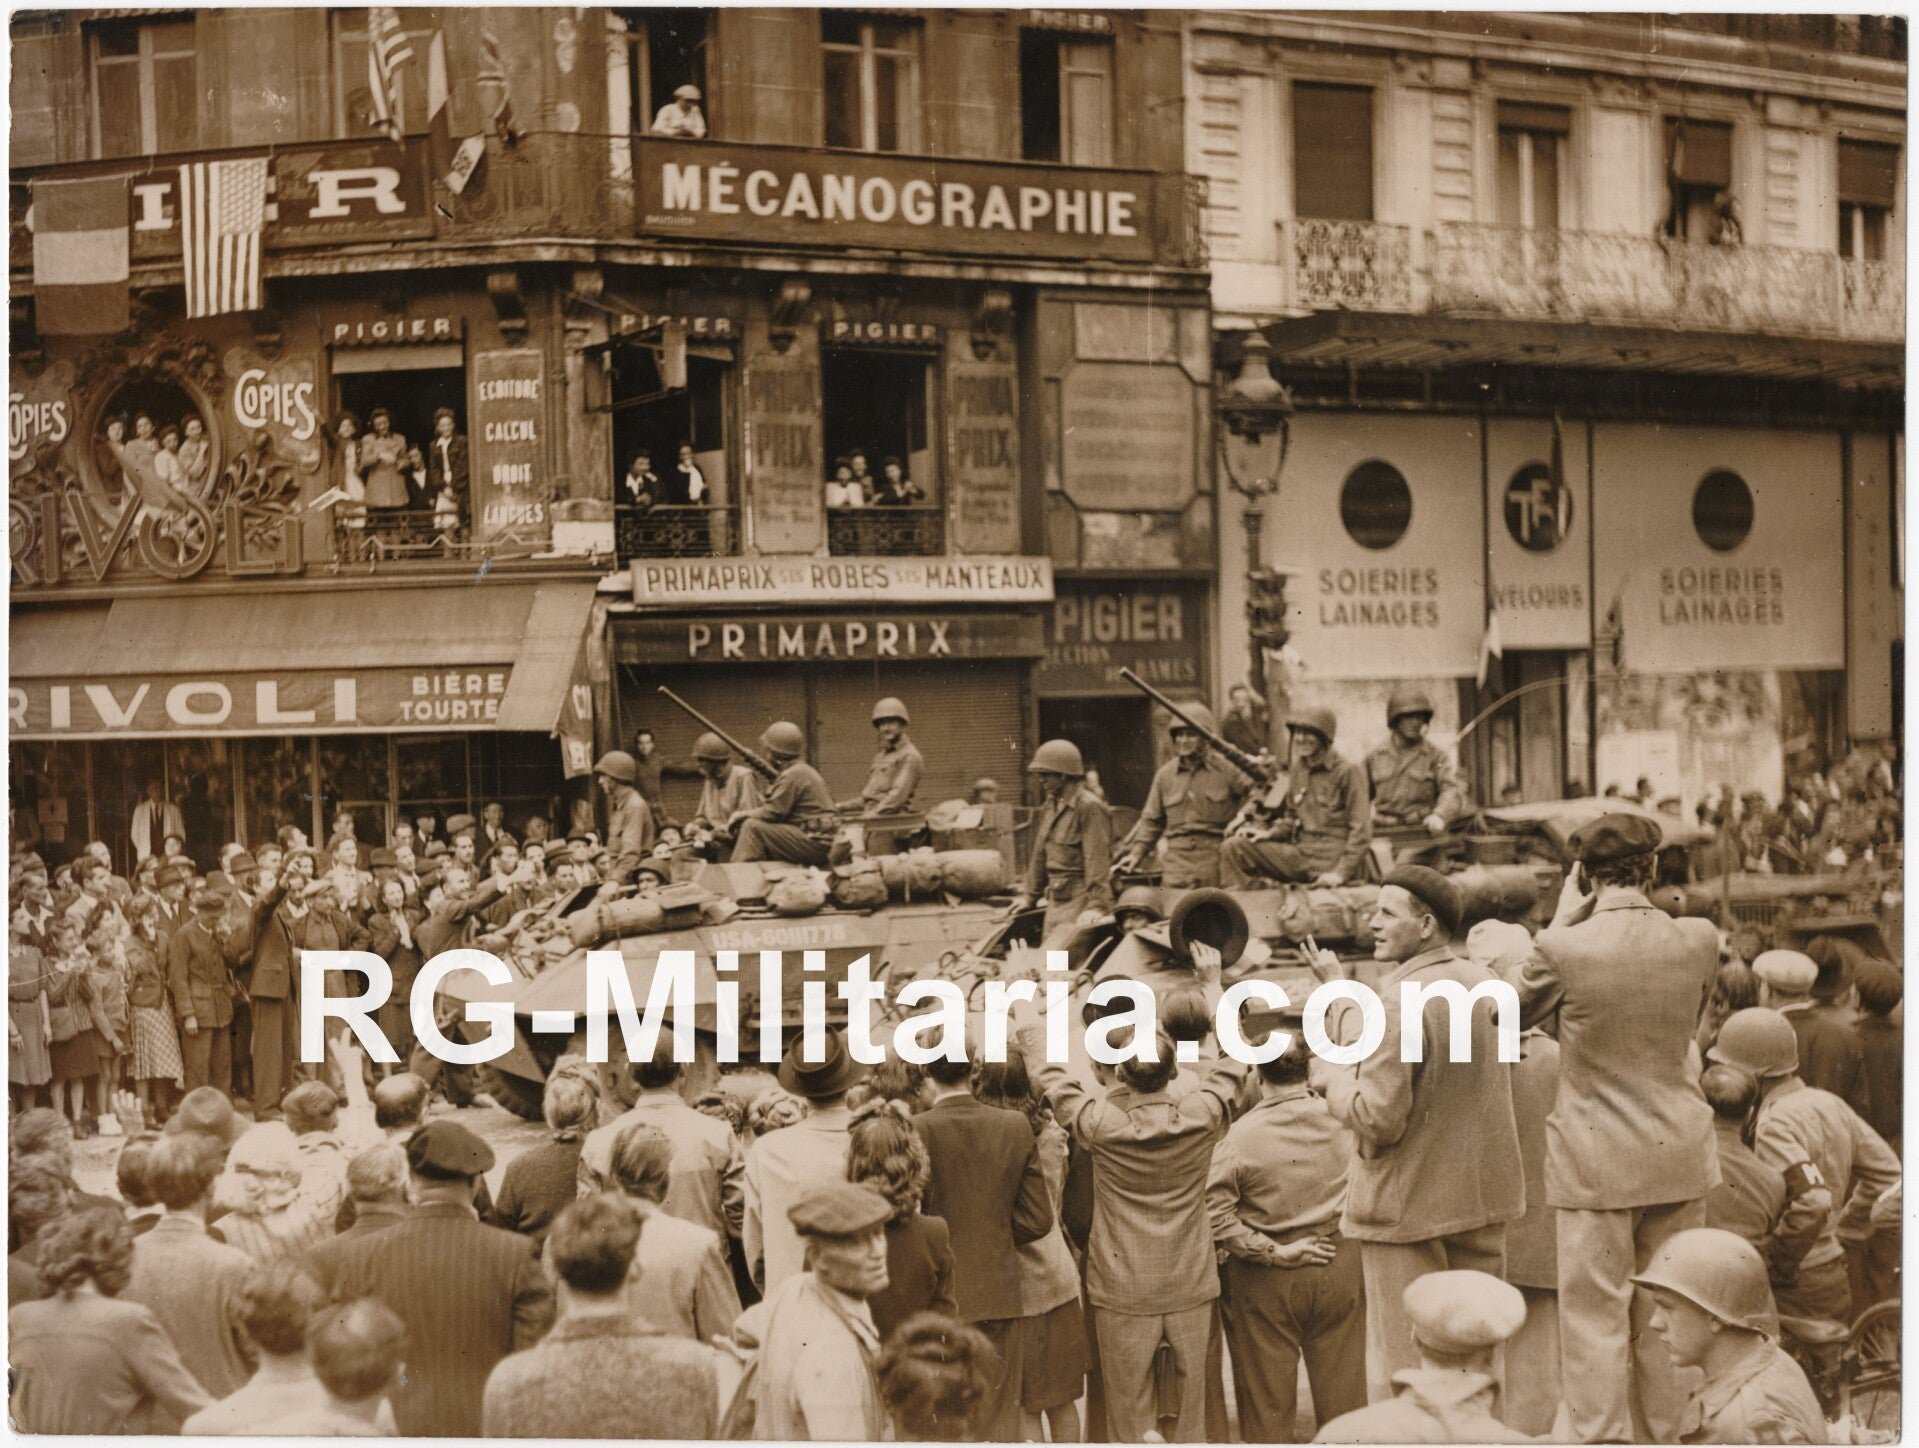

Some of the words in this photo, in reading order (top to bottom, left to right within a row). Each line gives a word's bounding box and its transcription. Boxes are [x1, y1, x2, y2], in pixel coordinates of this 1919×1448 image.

[662, 159, 1138, 237] MÉCANOGRAPHIE
[334, 318, 450, 340] PIGIER
[833, 321, 938, 340] PIGIER
[234, 368, 316, 441] COPIES
[485, 419, 538, 442] CALCUL
[646, 564, 777, 593] PRIMAPRIX
[810, 563, 890, 590] ROBES
[925, 562, 1045, 590] MANTEAUX
[1318, 566, 1439, 596] SOIERIES
[1660, 565, 1783, 597] SOIERIES
[1053, 594, 1184, 643] PIGIER
[1318, 600, 1440, 628] LAINAGES
[1659, 598, 1784, 626] LAINAGES
[687, 620, 953, 659] PRIMAPRIX
